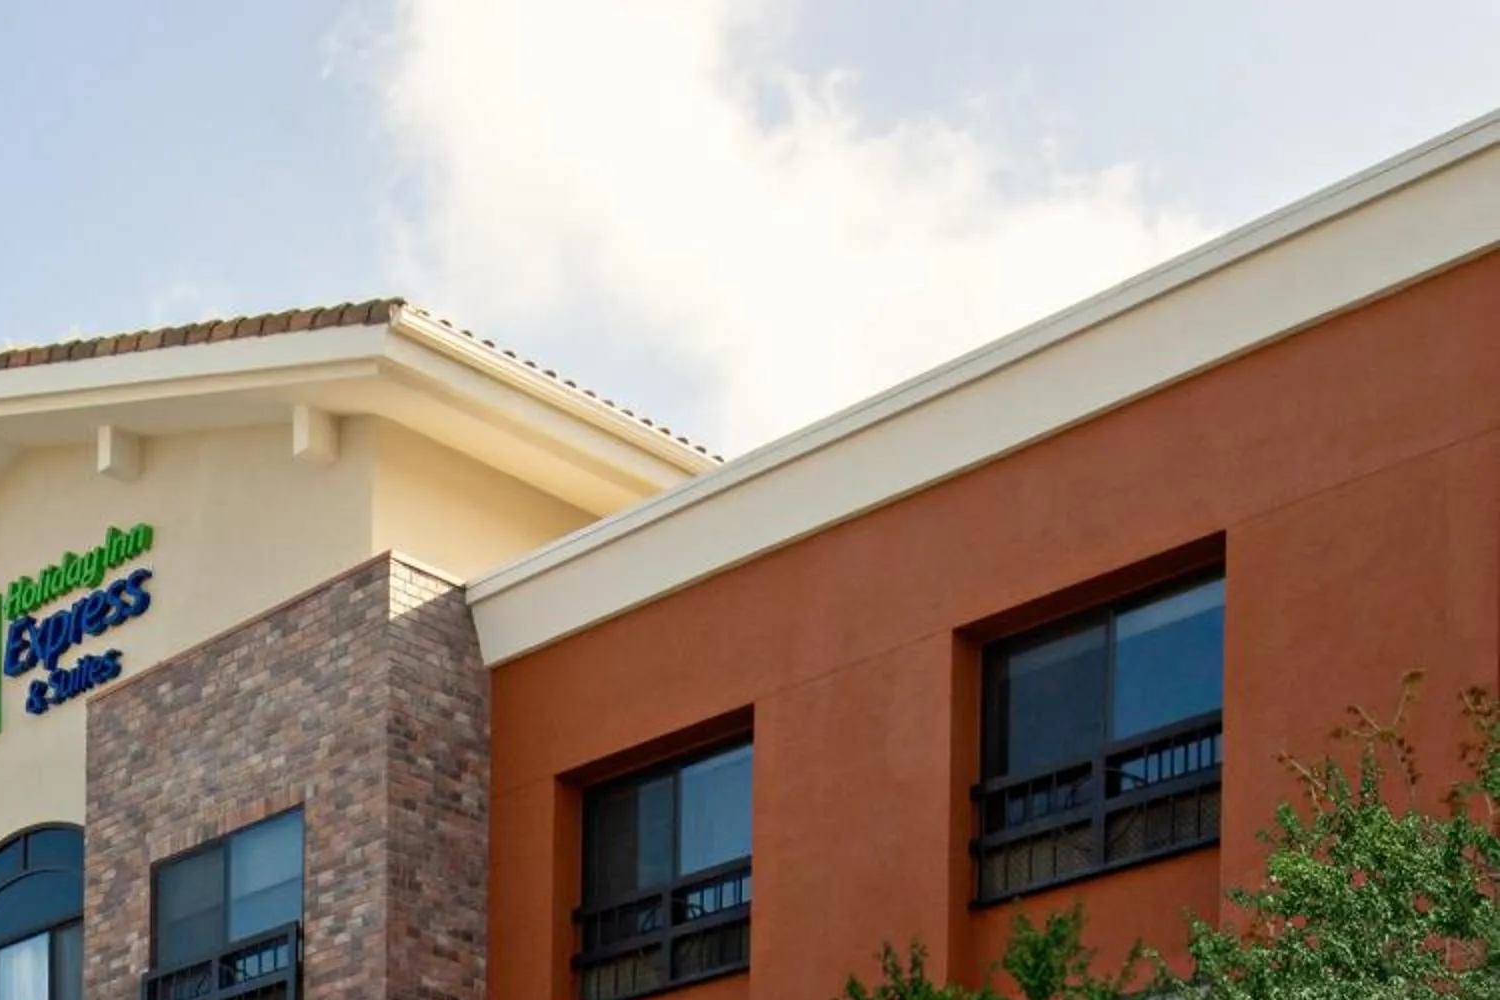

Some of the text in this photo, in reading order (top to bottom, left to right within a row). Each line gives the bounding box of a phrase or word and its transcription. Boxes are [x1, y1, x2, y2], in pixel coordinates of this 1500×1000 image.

[4, 522, 153, 619] Holiday Inn
[4, 568, 152, 677] Express
[26, 648, 123, 715] & Suites
